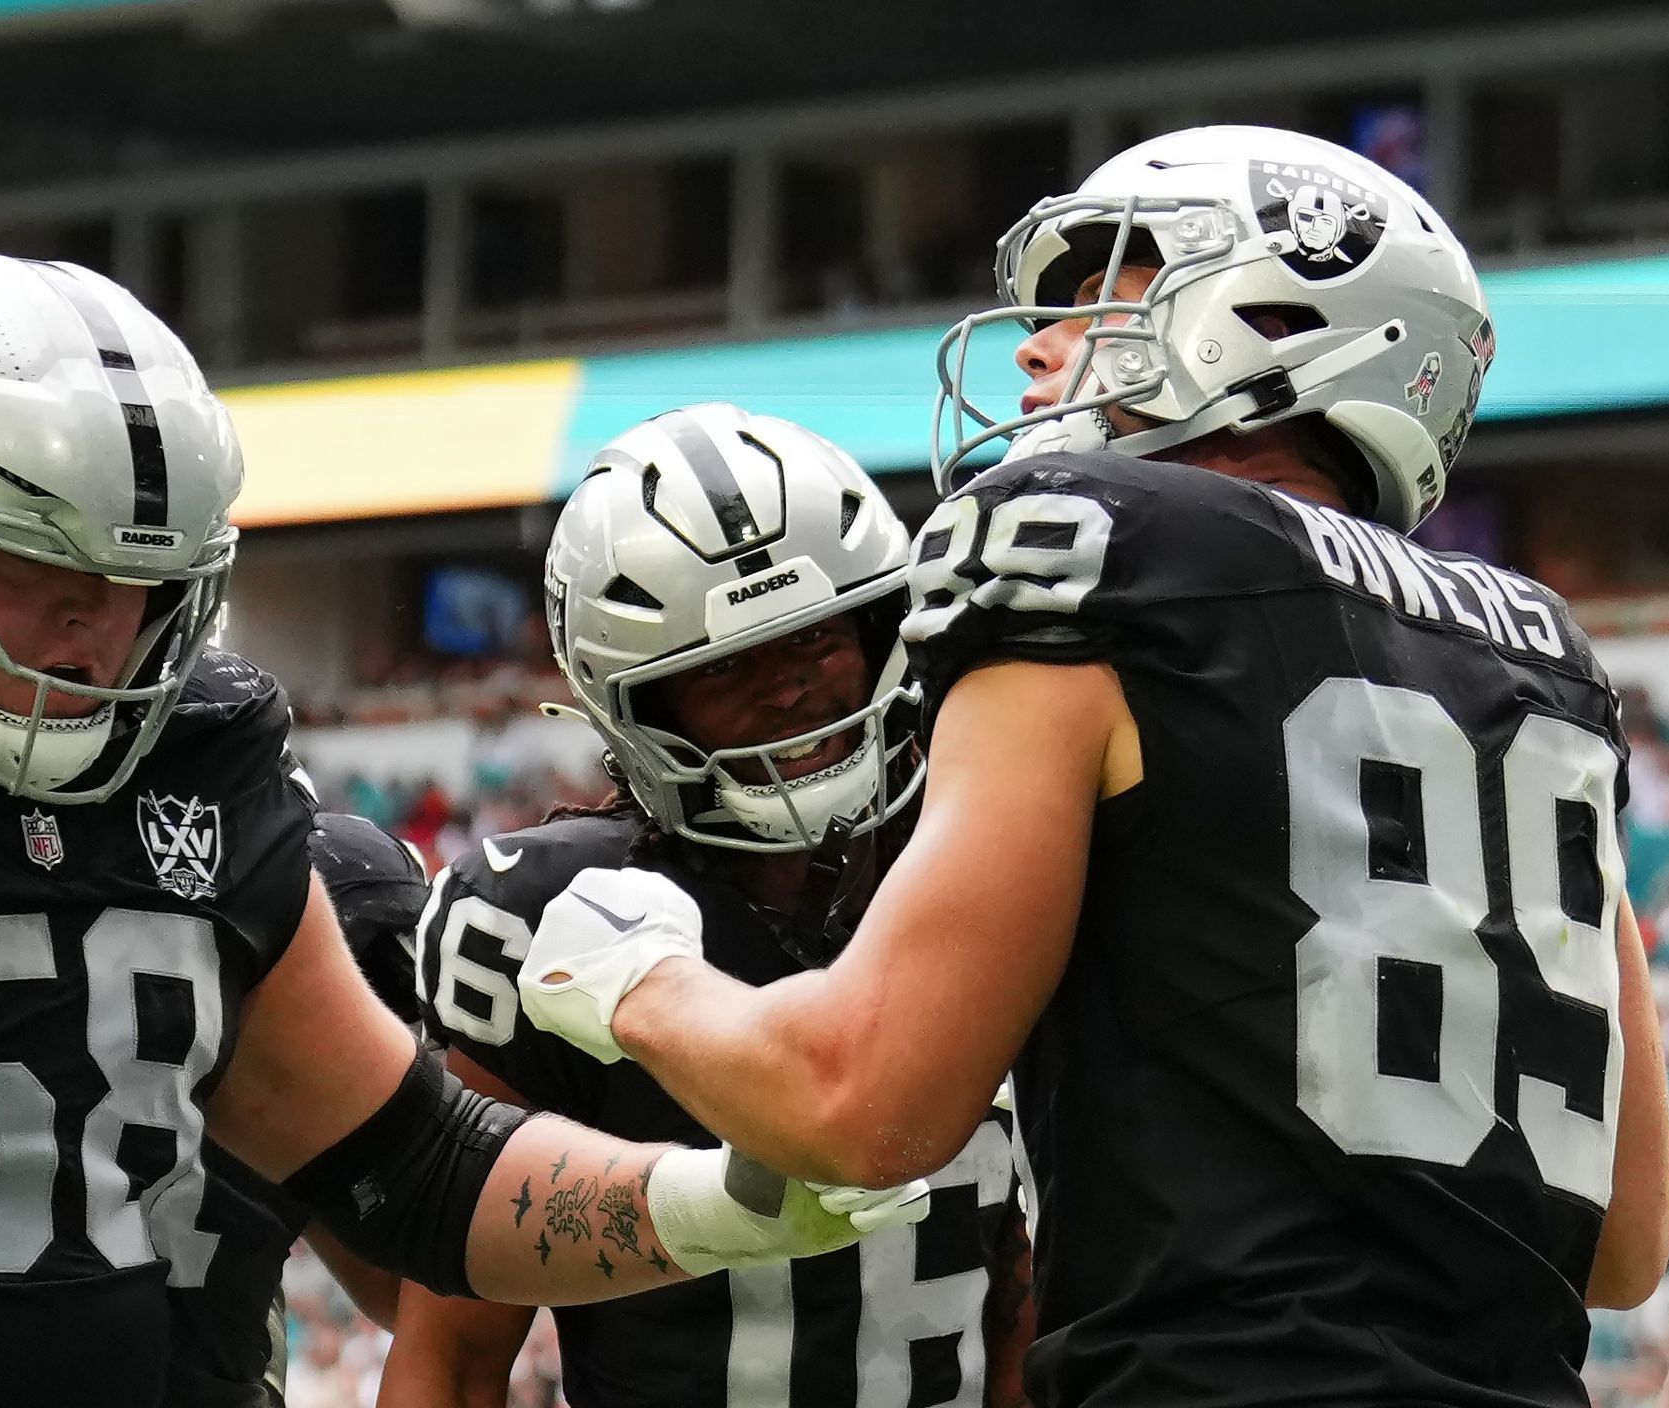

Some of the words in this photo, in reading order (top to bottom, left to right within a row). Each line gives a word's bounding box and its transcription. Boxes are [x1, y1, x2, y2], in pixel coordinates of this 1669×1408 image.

[1262, 162, 1377, 204] RAIDERS
[121, 531, 175, 547] RAIDERS
[726, 569, 800, 606] RAIDERS
[899, 494, 1113, 643] 89
[1271, 489, 1566, 660] BOWERS
[31, 836, 58, 857] NFL
[147, 821, 214, 860] LXV
[1282, 677, 1627, 1210] 89
